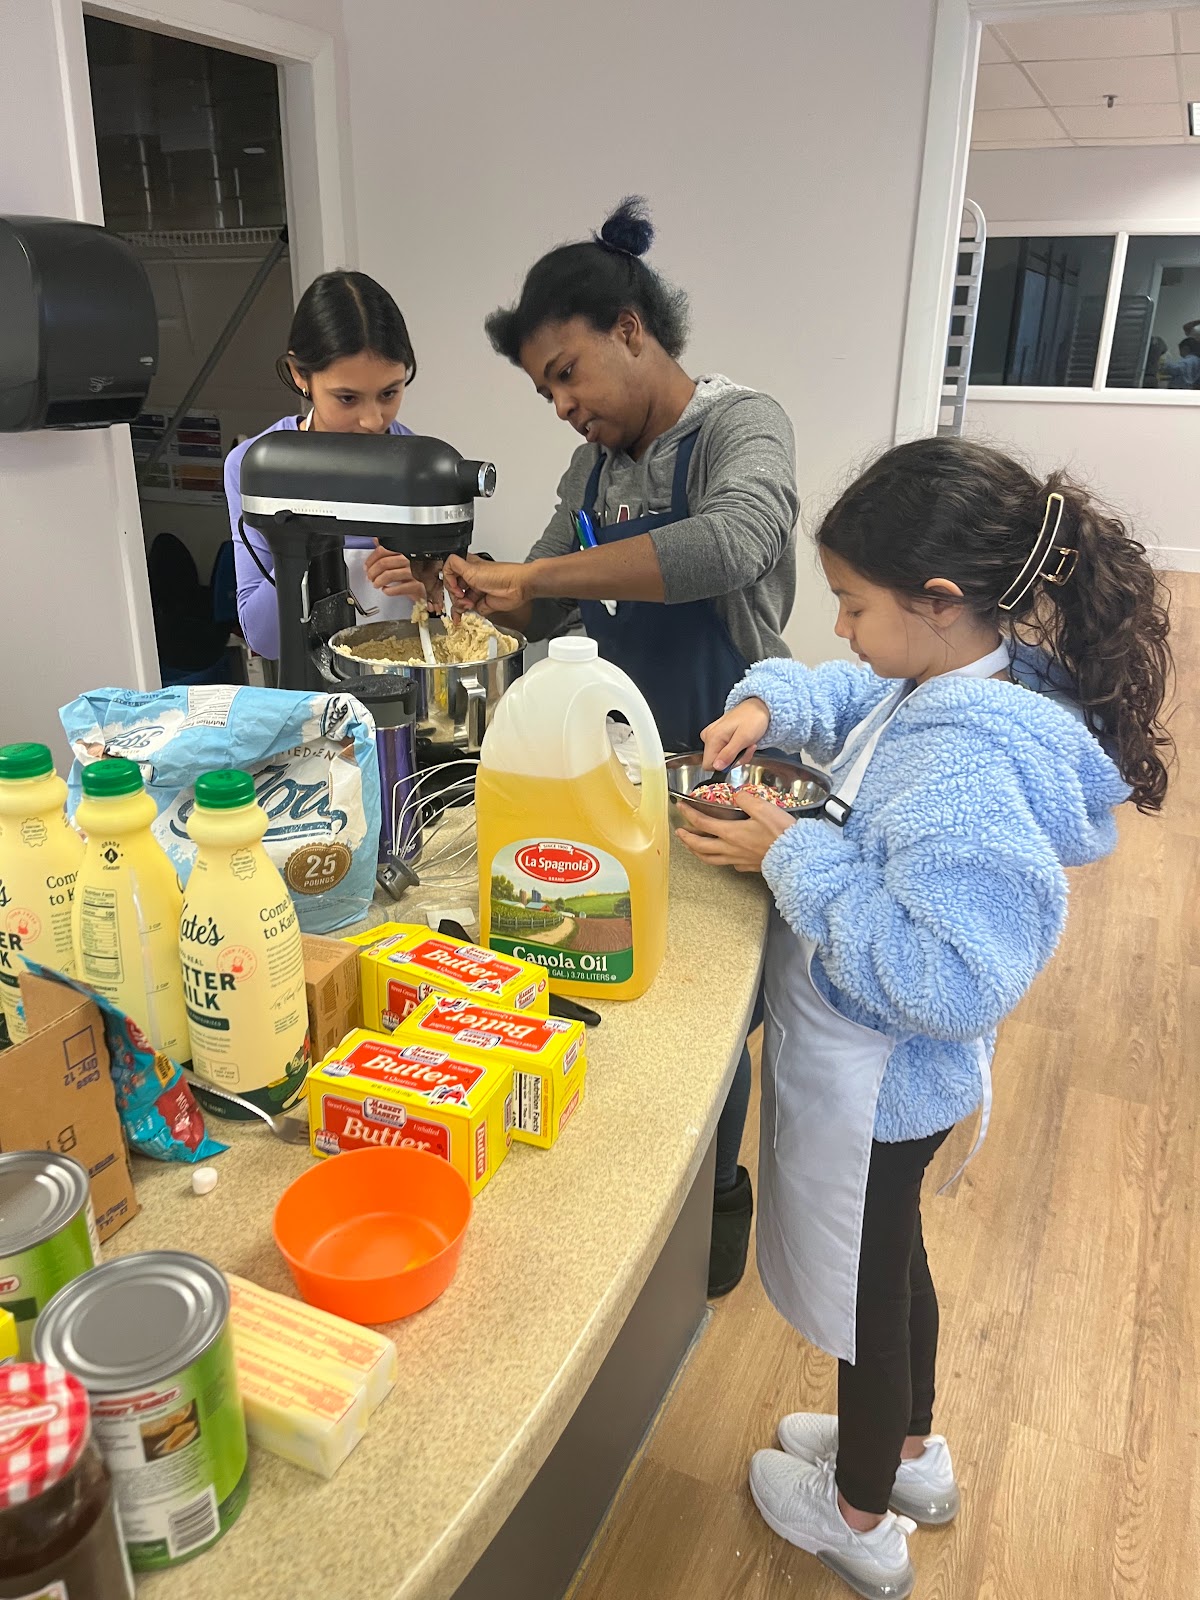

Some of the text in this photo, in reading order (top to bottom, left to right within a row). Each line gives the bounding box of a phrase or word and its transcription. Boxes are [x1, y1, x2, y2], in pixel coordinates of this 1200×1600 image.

[305, 853, 337, 878] 25
[525, 855, 589, 873] La Spagnola
[304, 876, 335, 887] POUNDS
[49, 892, 65, 906] to
[259, 899, 288, 922] Come
[263, 924, 278, 940] to
[422, 949, 498, 979] Butter
[512, 946, 608, 971] Canola Oil
[182, 963, 237, 991] TTER
[552, 970, 610, 981] GAL.) 3.78 LITERS
[446, 1011, 536, 1039] Butter
[414, 1046, 445, 1057] MARKET
[63, 1070, 76, 1087] 12
[76, 1069, 101, 1090] Case
[362, 1054, 458, 1085] Butter
[369, 1098, 403, 1114] MARKET
[371, 1107, 401, 1121] BASKET
[532, 1076, 541, 1133] Nutrition Facts
[342, 1116, 431, 1150] Butter
[476, 1126, 486, 1175] Butter
